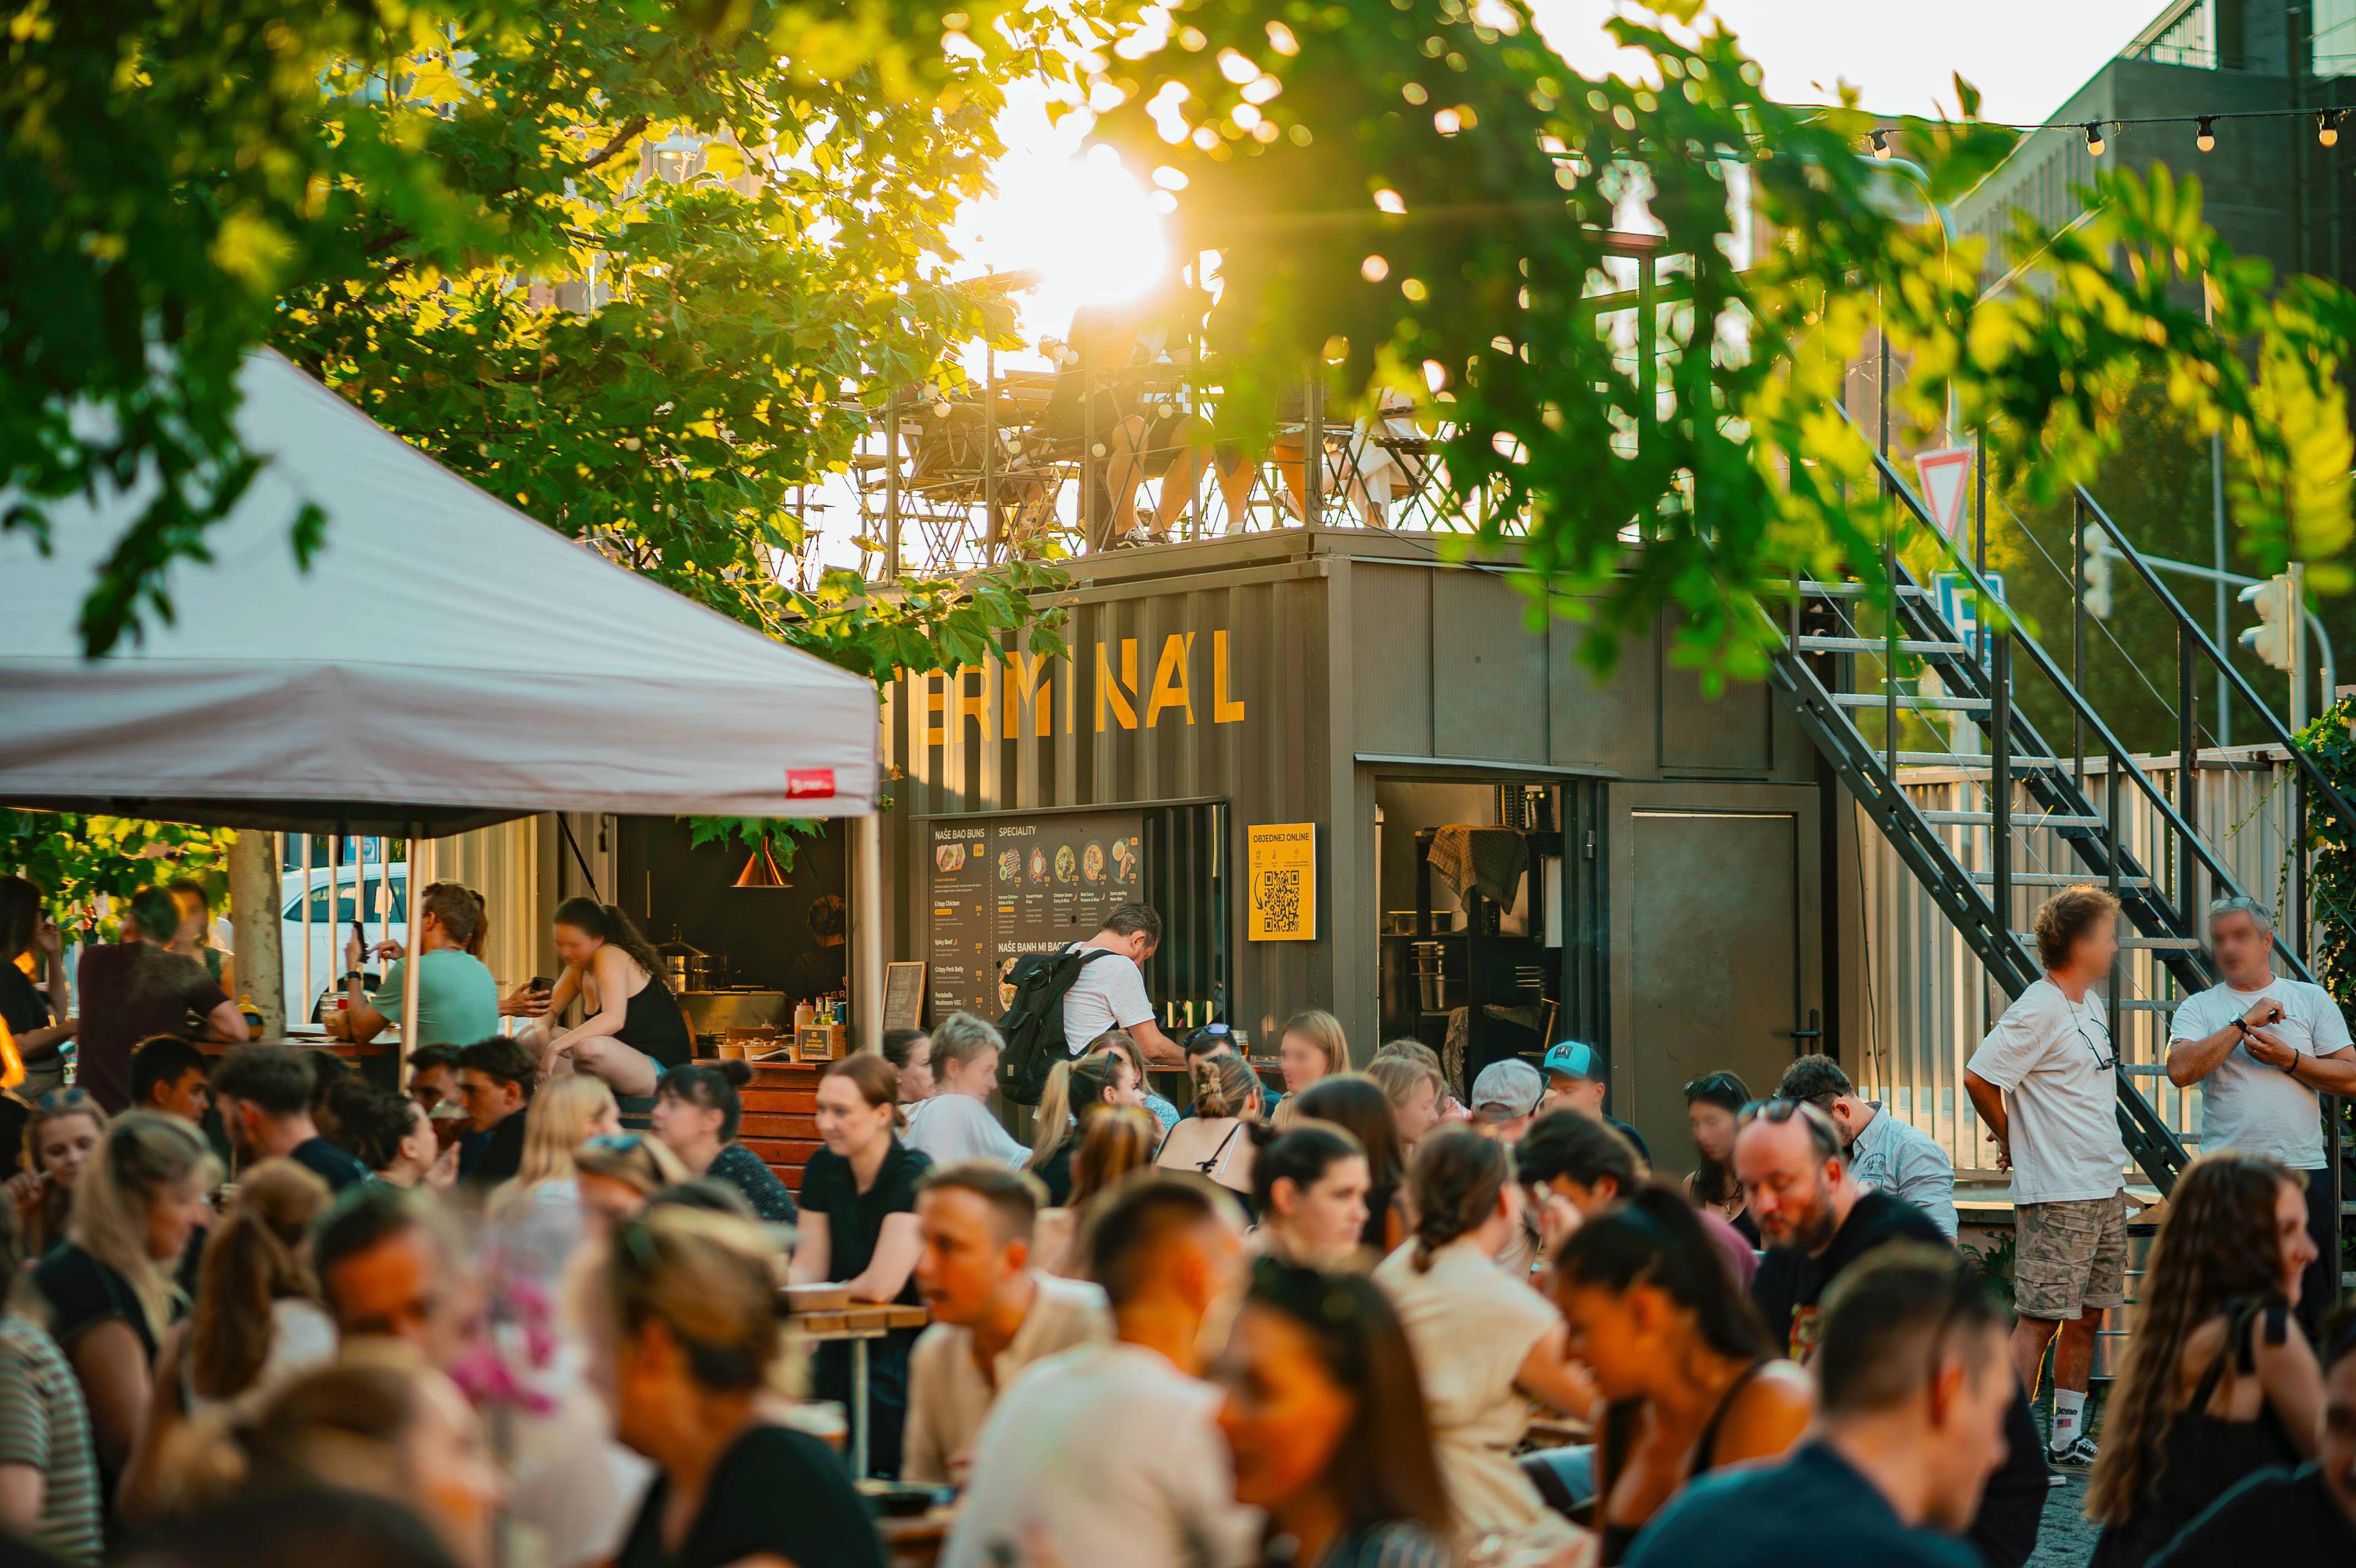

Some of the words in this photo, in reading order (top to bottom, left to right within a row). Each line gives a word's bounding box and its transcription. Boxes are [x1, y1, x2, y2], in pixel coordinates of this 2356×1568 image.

[871, 630, 1244, 750] ERMINAL
[935, 828, 952, 840] NAŠE
[952, 829, 966, 839] BAO
[967, 828, 985, 838] BUNS
[998, 825, 1037, 836] SPECIALITY
[1253, 833, 1285, 843] OBJEDNEJ
[1286, 833, 1309, 842] ONLINE
[998, 941, 1016, 952] NAŠE
[1017, 942, 1037, 952] BANH
[1038, 942, 1046, 952] MI
